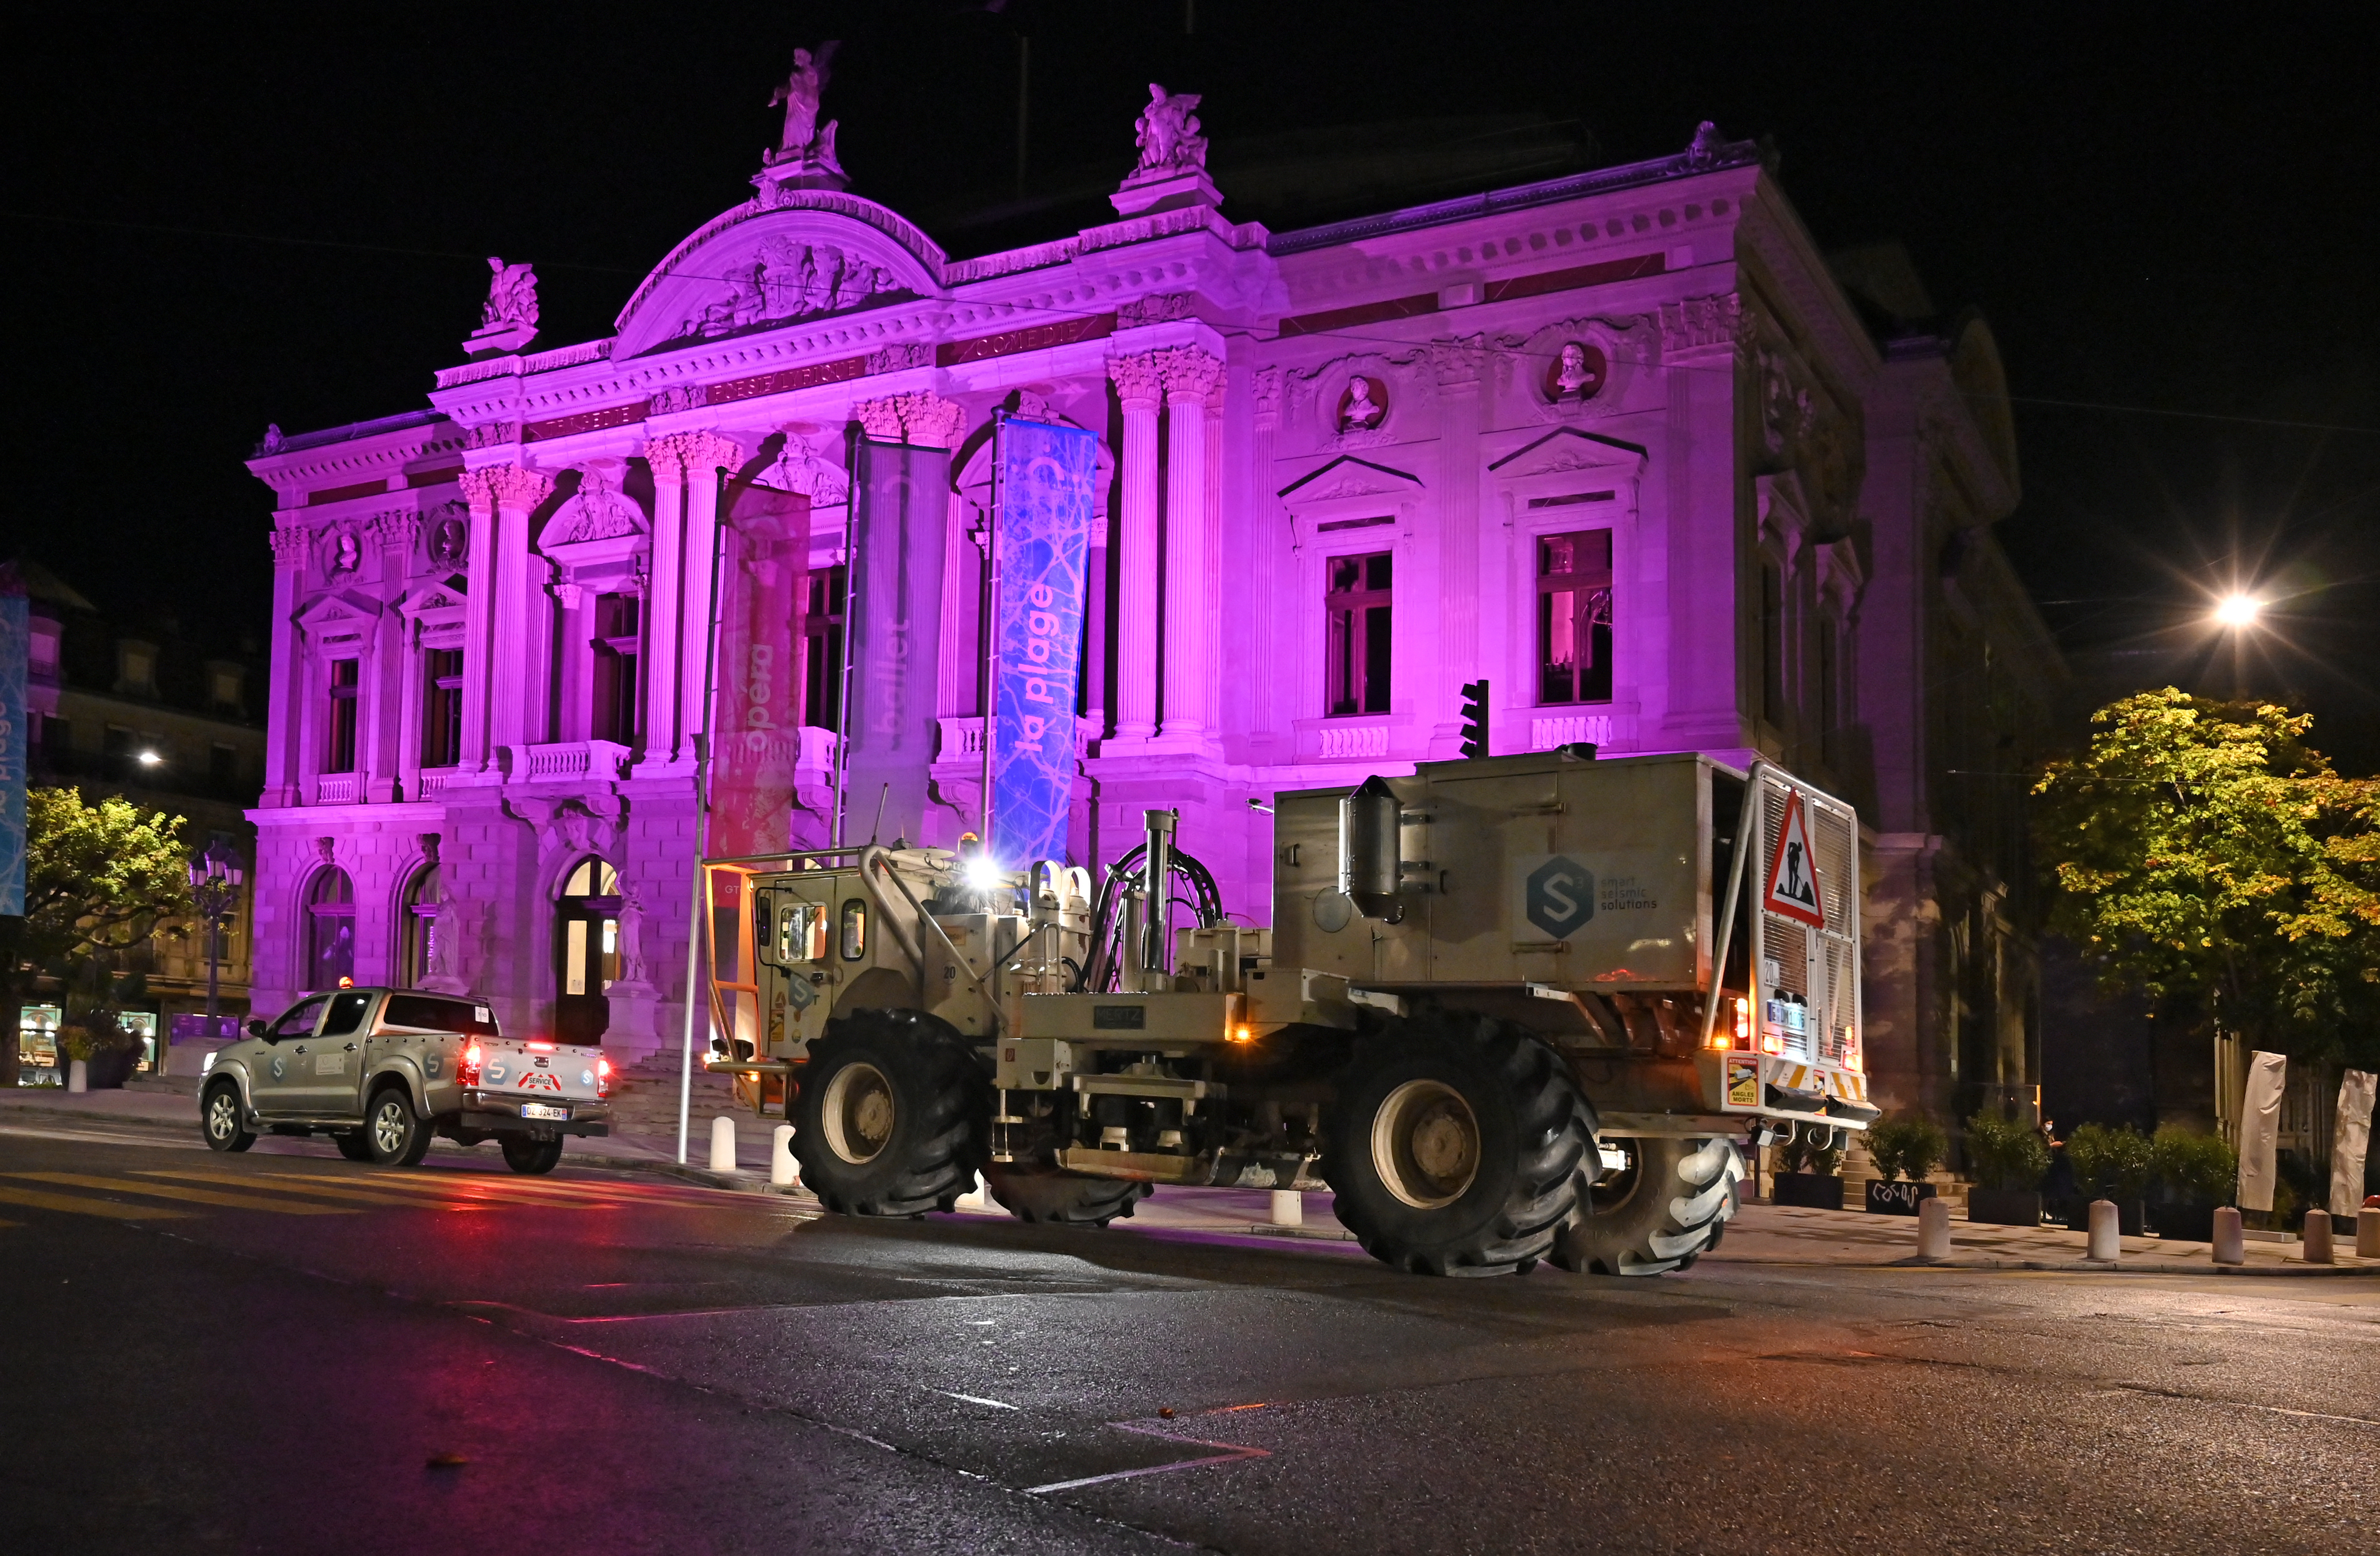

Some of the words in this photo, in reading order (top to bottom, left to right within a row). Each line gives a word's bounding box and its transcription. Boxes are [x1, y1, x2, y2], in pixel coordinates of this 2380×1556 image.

[781, 360, 856, 389] LYRIQUE
[1018, 583, 1060, 704] plage
[870, 617, 909, 734] ballet
[1014, 714, 1044, 752] la
[1601, 877, 1636, 887] smart
[1601, 888, 1647, 899] seismic
[1601, 899, 1657, 911] solutions
[943, 966, 956, 979] 20
[1765, 962, 1773, 984] 20
[1096, 1008, 1142, 1021] MERTZ
[529, 1077, 552, 1085] SERVICE
